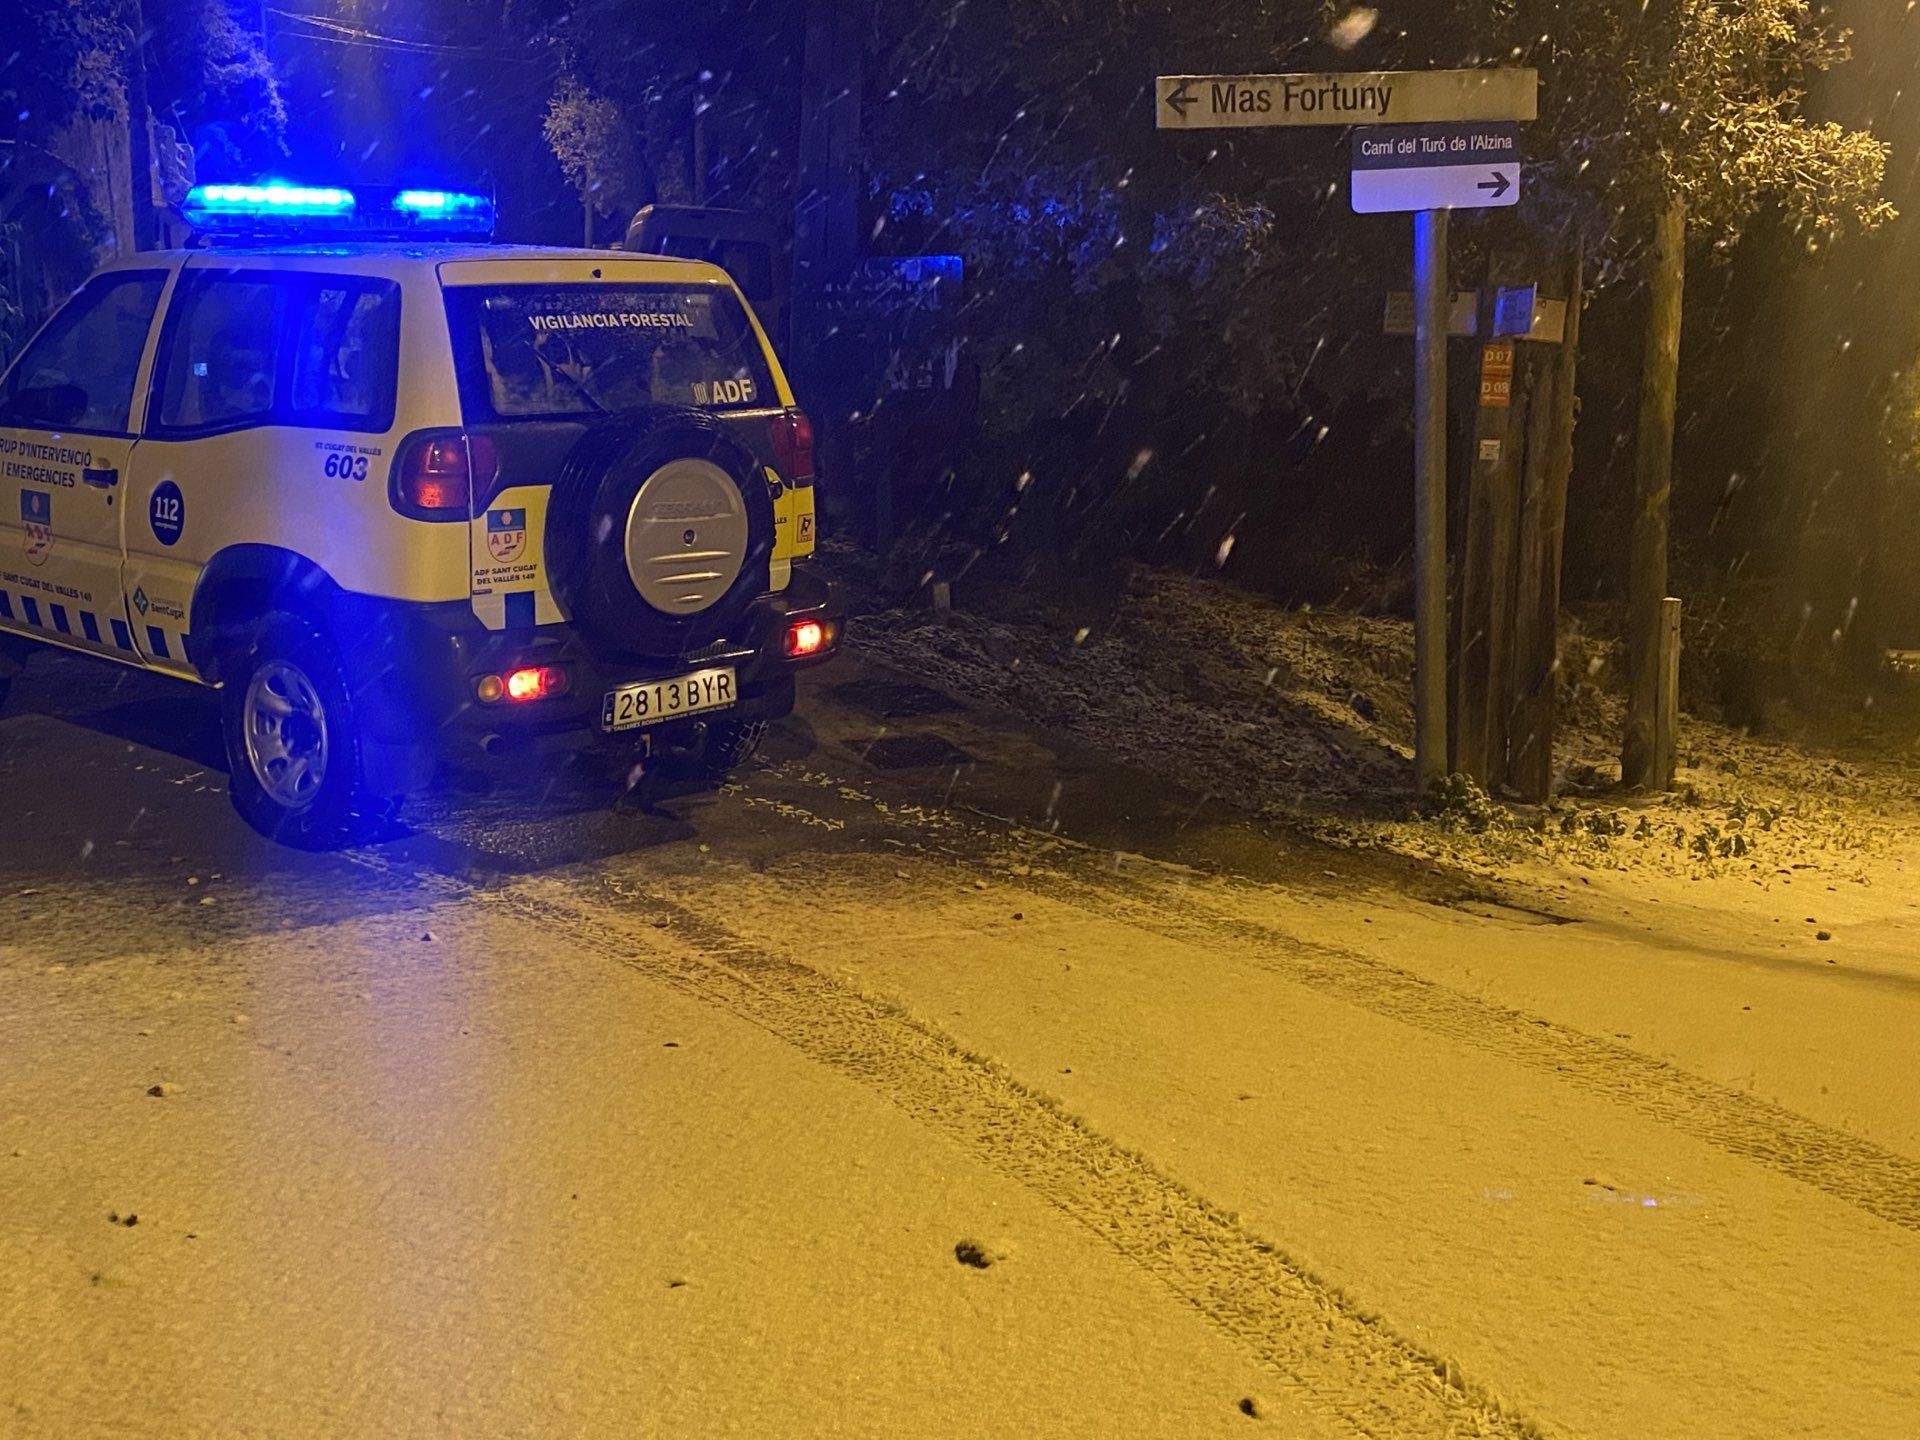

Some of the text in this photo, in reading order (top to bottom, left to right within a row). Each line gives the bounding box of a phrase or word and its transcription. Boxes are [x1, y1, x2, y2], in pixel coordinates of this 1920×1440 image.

[1211, 82, 1393, 116] Mas Fortuny
[1361, 134, 1513, 156] Camí del Turó de l'Alzina
[620, 313, 694, 328] FORESTAL
[713, 380, 752, 404] ADF
[325, 453, 368, 482] 603
[155, 496, 179, 522] 112
[491, 566, 512, 575] SANT
[513, 564, 537, 573] CUGAT
[476, 578, 491, 586] DEL
[619, 684, 681, 720] 2813
[687, 673, 731, 707] BYR
